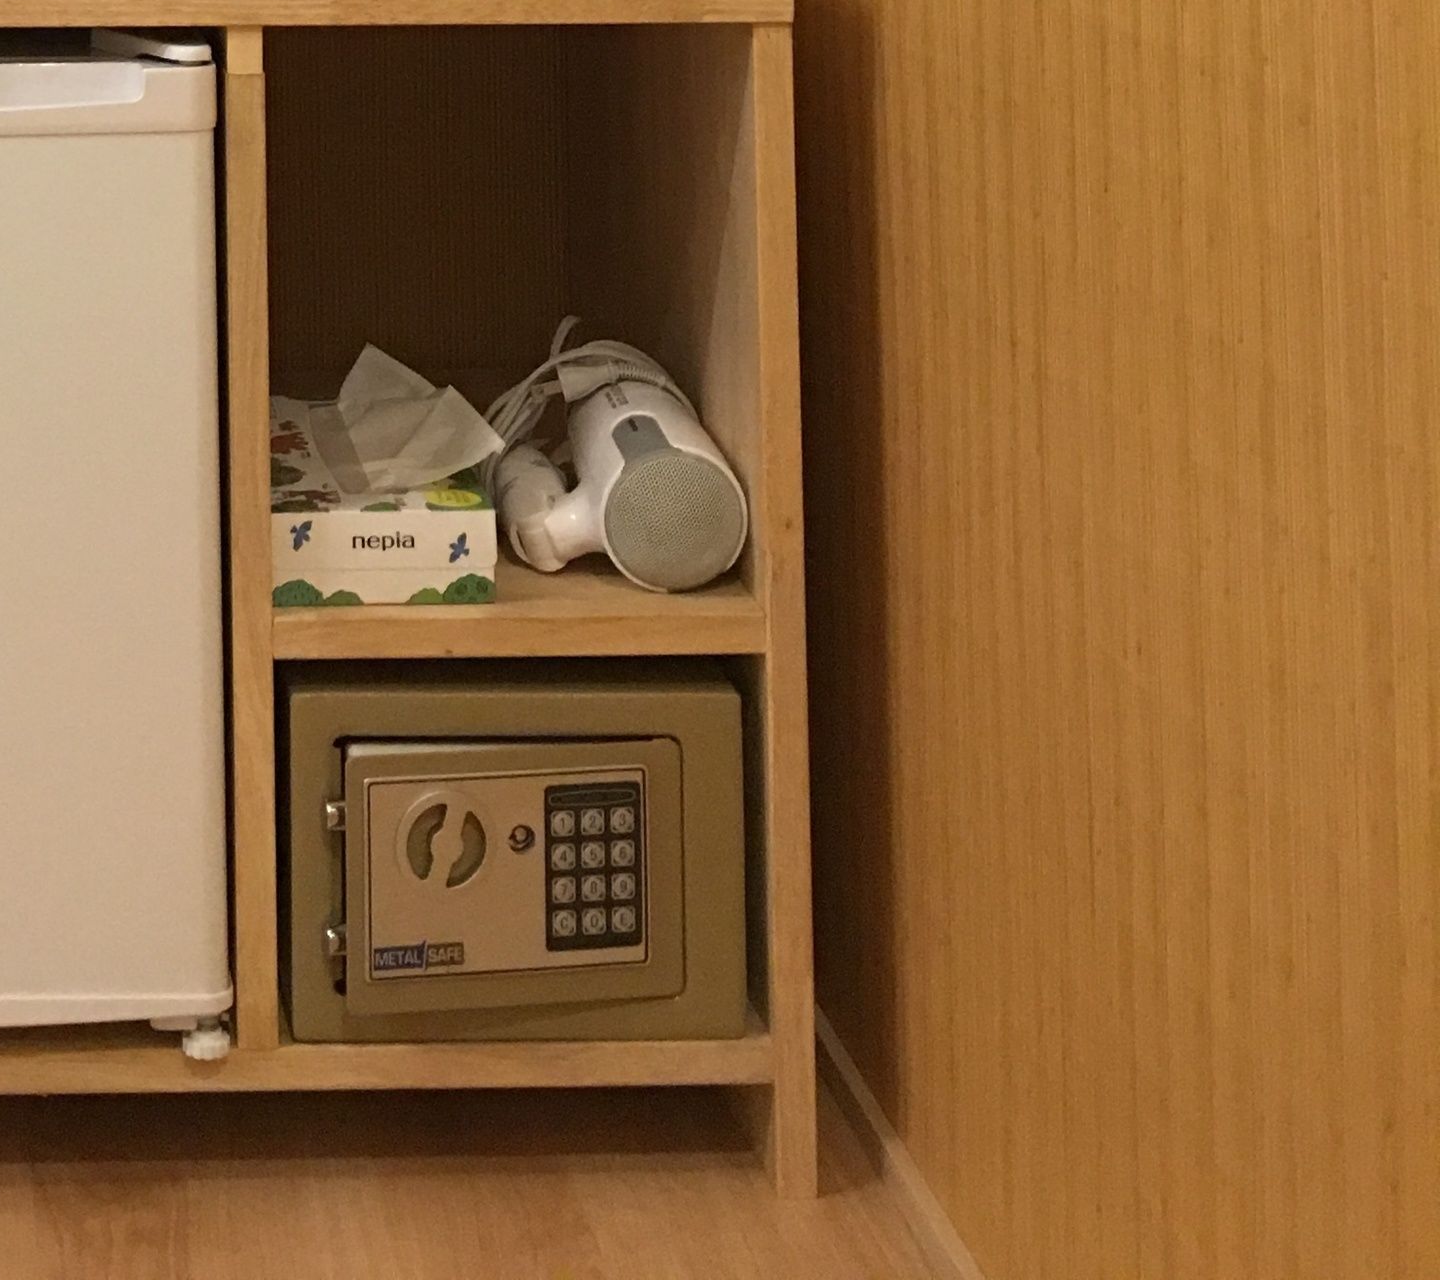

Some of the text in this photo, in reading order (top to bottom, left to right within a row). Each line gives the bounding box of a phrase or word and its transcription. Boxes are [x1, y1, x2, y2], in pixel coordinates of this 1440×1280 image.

[351, 531, 416, 553] nepia
[375, 946, 464, 966] METAL SAFE
